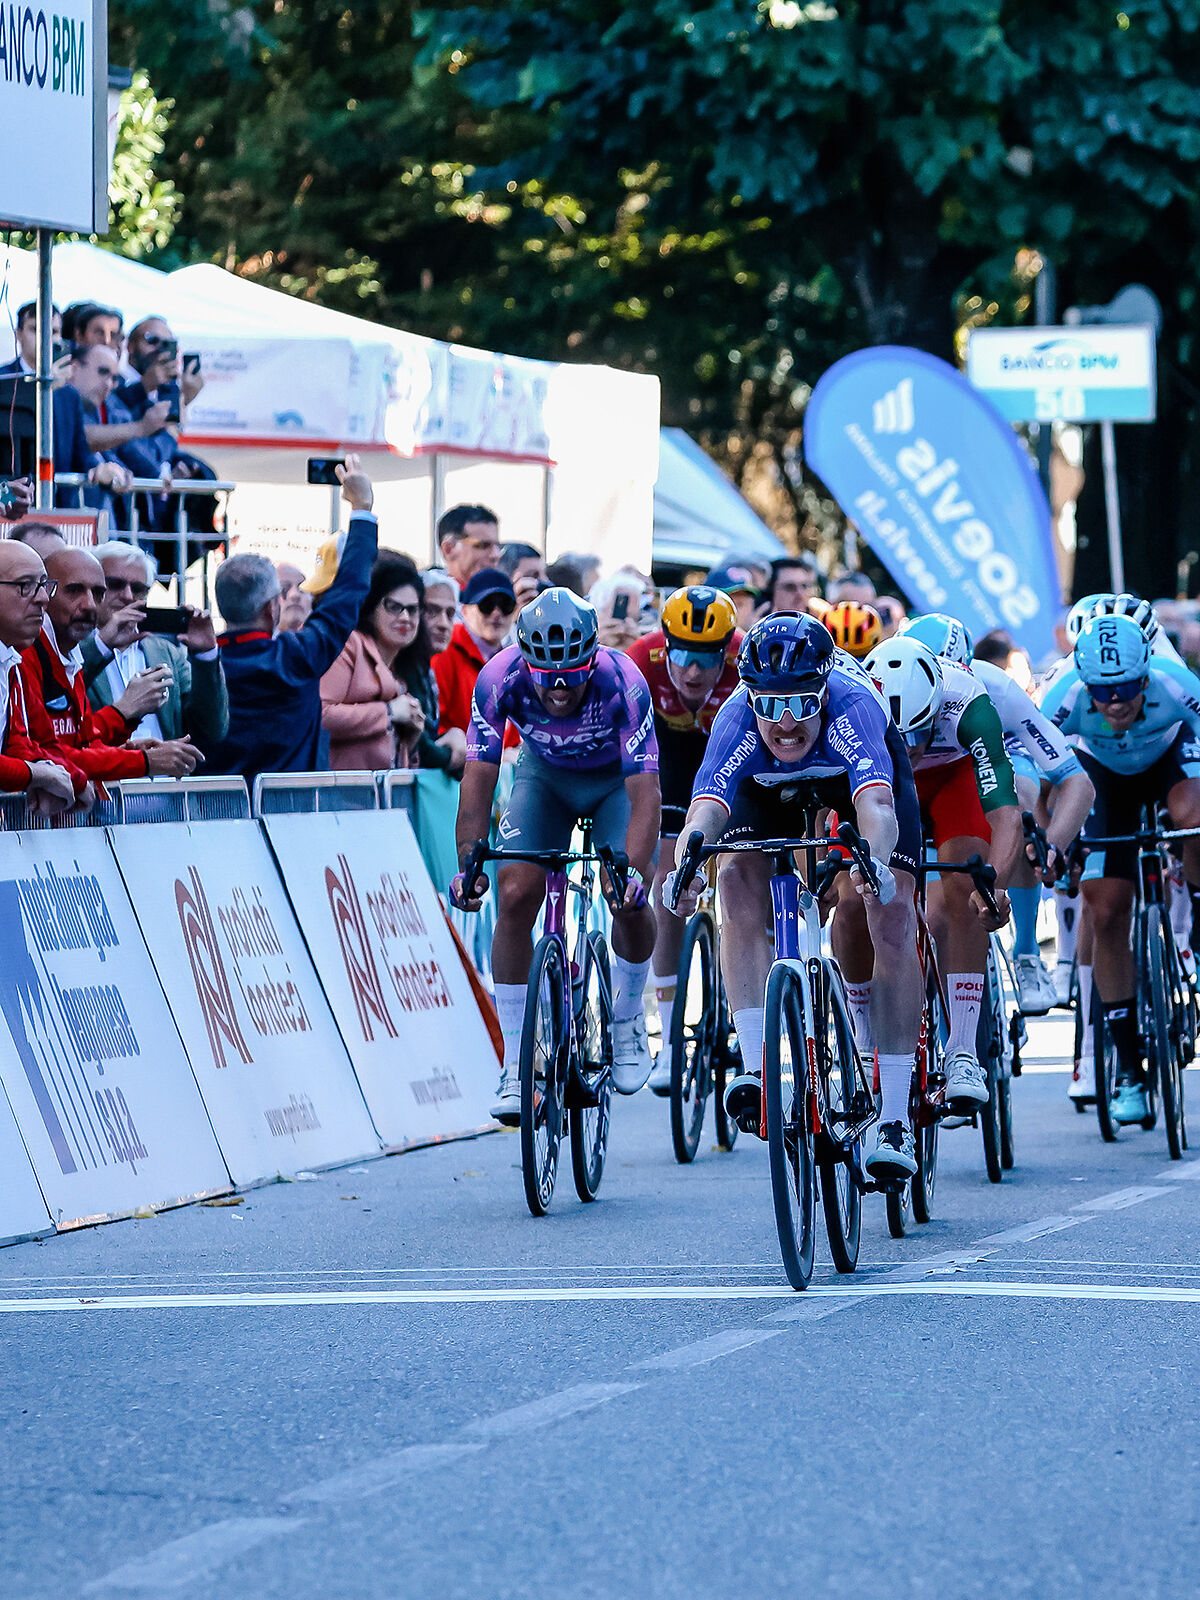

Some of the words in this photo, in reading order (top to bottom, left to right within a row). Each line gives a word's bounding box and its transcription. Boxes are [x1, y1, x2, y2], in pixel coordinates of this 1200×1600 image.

[0, 1, 48, 89] ANCO
[52, 13, 84, 97] BPM
[969, 736, 999, 796] KOMETA
[1020, 718, 1059, 761] MERIDA
[723, 826, 754, 840] RYSEL
[891, 851, 917, 868] RYSEL
[19, 859, 120, 961] metallurgica
[216, 884, 284, 958] profilati
[365, 871, 428, 938] profilati
[49, 972, 141, 1076] legnanese
